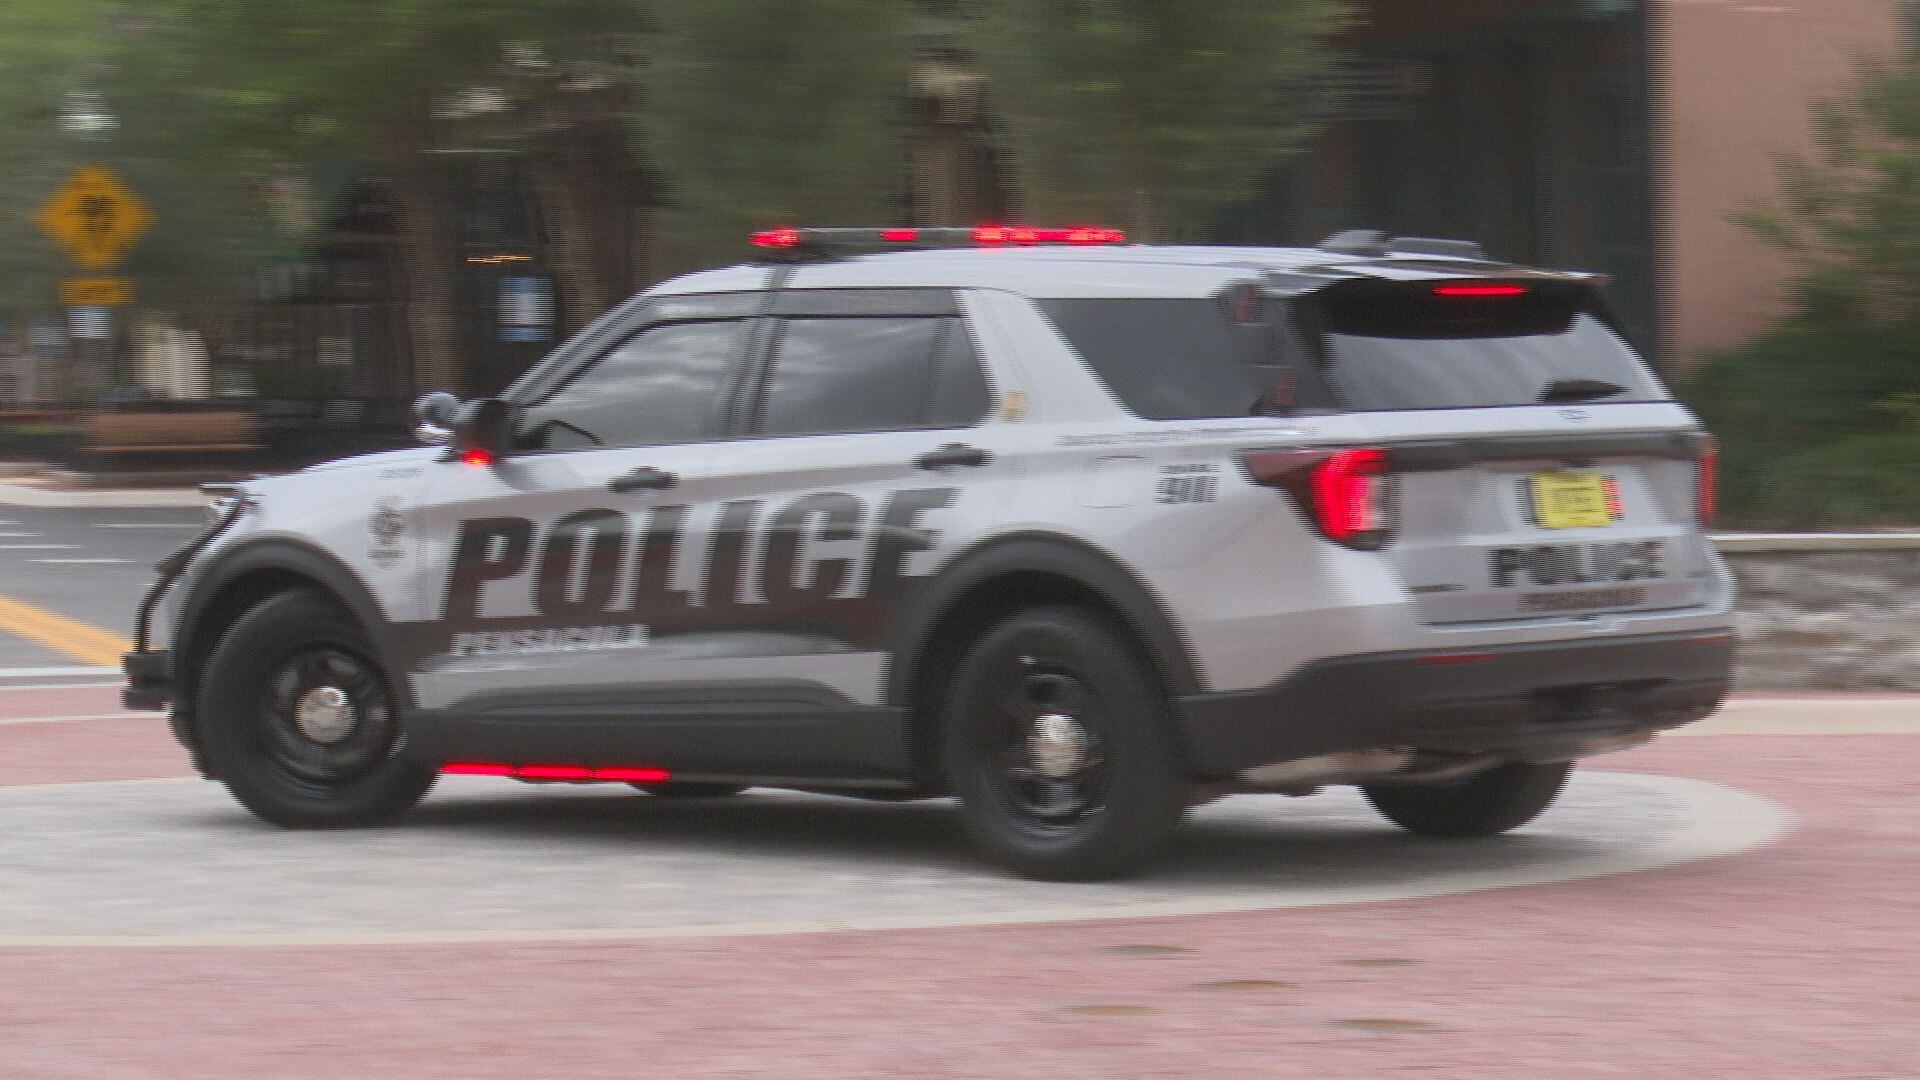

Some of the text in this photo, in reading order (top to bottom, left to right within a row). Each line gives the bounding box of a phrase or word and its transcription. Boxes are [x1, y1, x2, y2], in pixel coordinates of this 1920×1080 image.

[1154, 476, 1218, 504] 911
[438, 487, 962, 620] POLICE
[1488, 541, 1664, 588] POLICE
[449, 623, 651, 656] PENSACOLA
